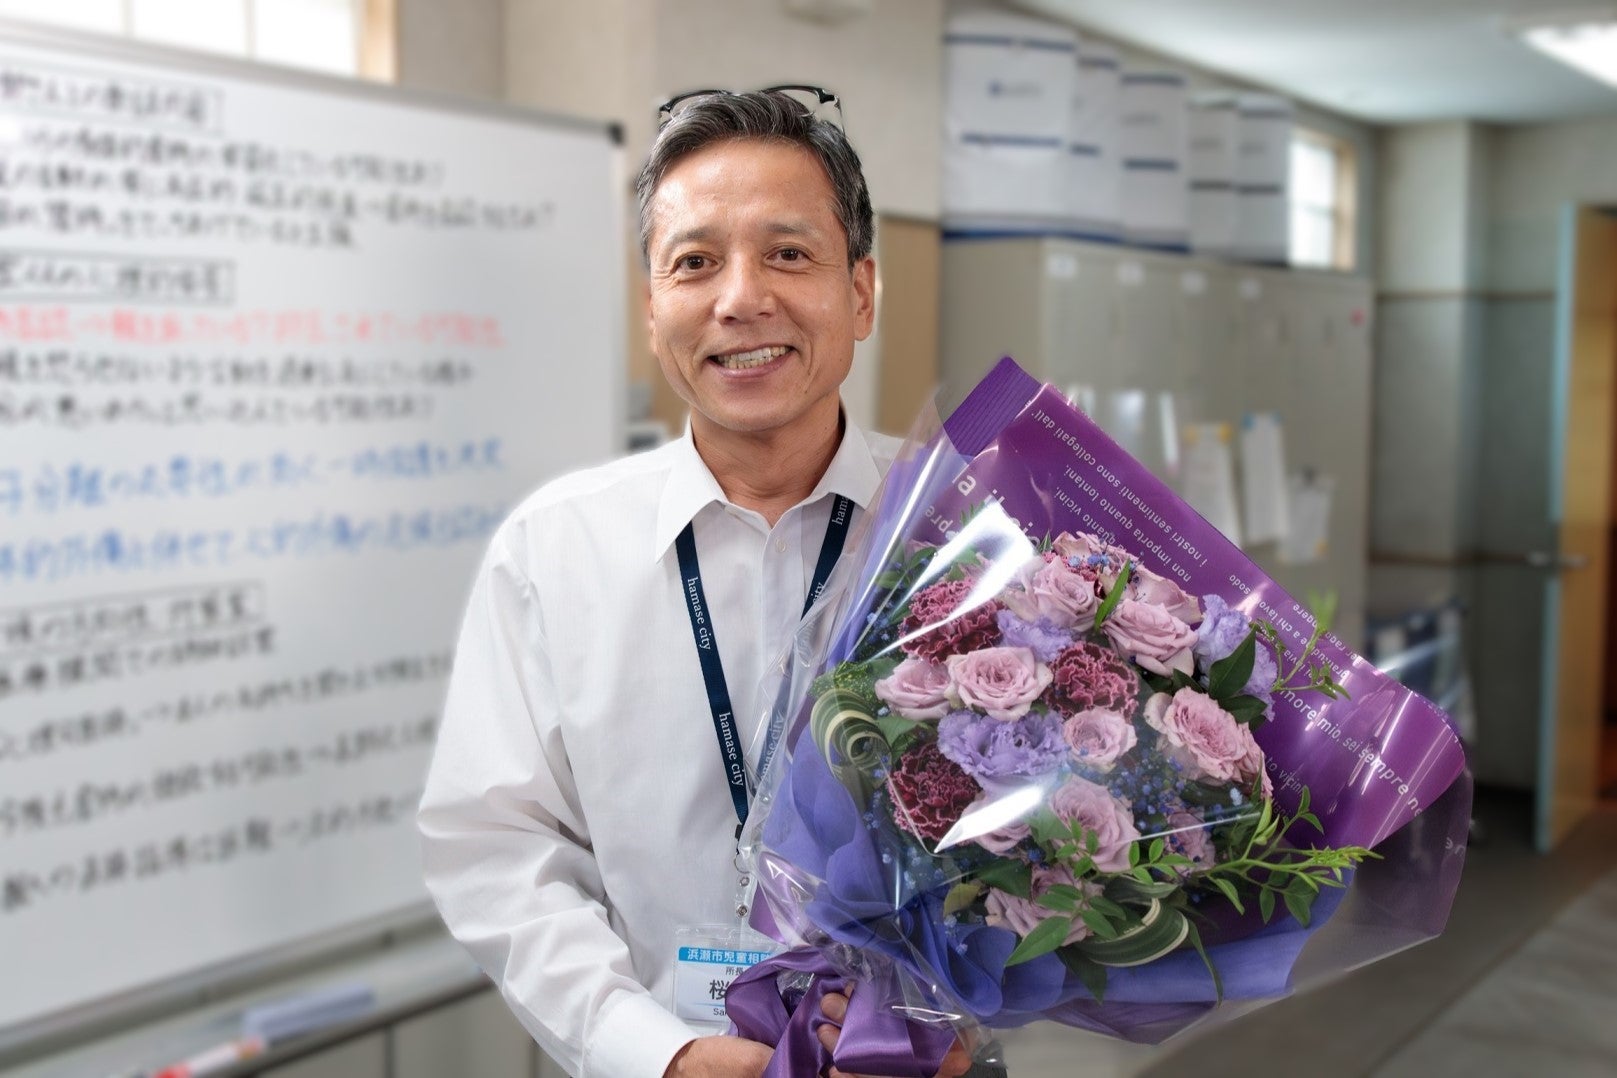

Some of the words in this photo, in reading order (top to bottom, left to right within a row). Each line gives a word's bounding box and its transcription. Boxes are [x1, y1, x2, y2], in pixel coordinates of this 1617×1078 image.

[1052, 425, 1098, 468] collegati
[1095, 463, 1121, 488] sono
[1096, 496, 1134, 531] quanto
[1117, 484, 1172, 536] sentimenti
[1080, 512, 1117, 546] quanto
[1130, 526, 1173, 566] importa
[1169, 531, 1202, 562] nostri
[1170, 562, 1191, 582] non
[1227, 573, 1251, 595] sodo
[687, 578, 704, 623] hamase
[695, 626, 712, 650] city
[1276, 617, 1293, 633] chi
[718, 712, 739, 761] hamase
[727, 761, 747, 788] city
[1341, 733, 1362, 753] sei
[1358, 747, 1410, 796] sempre
[713, 1007, 727, 1016] Sa
